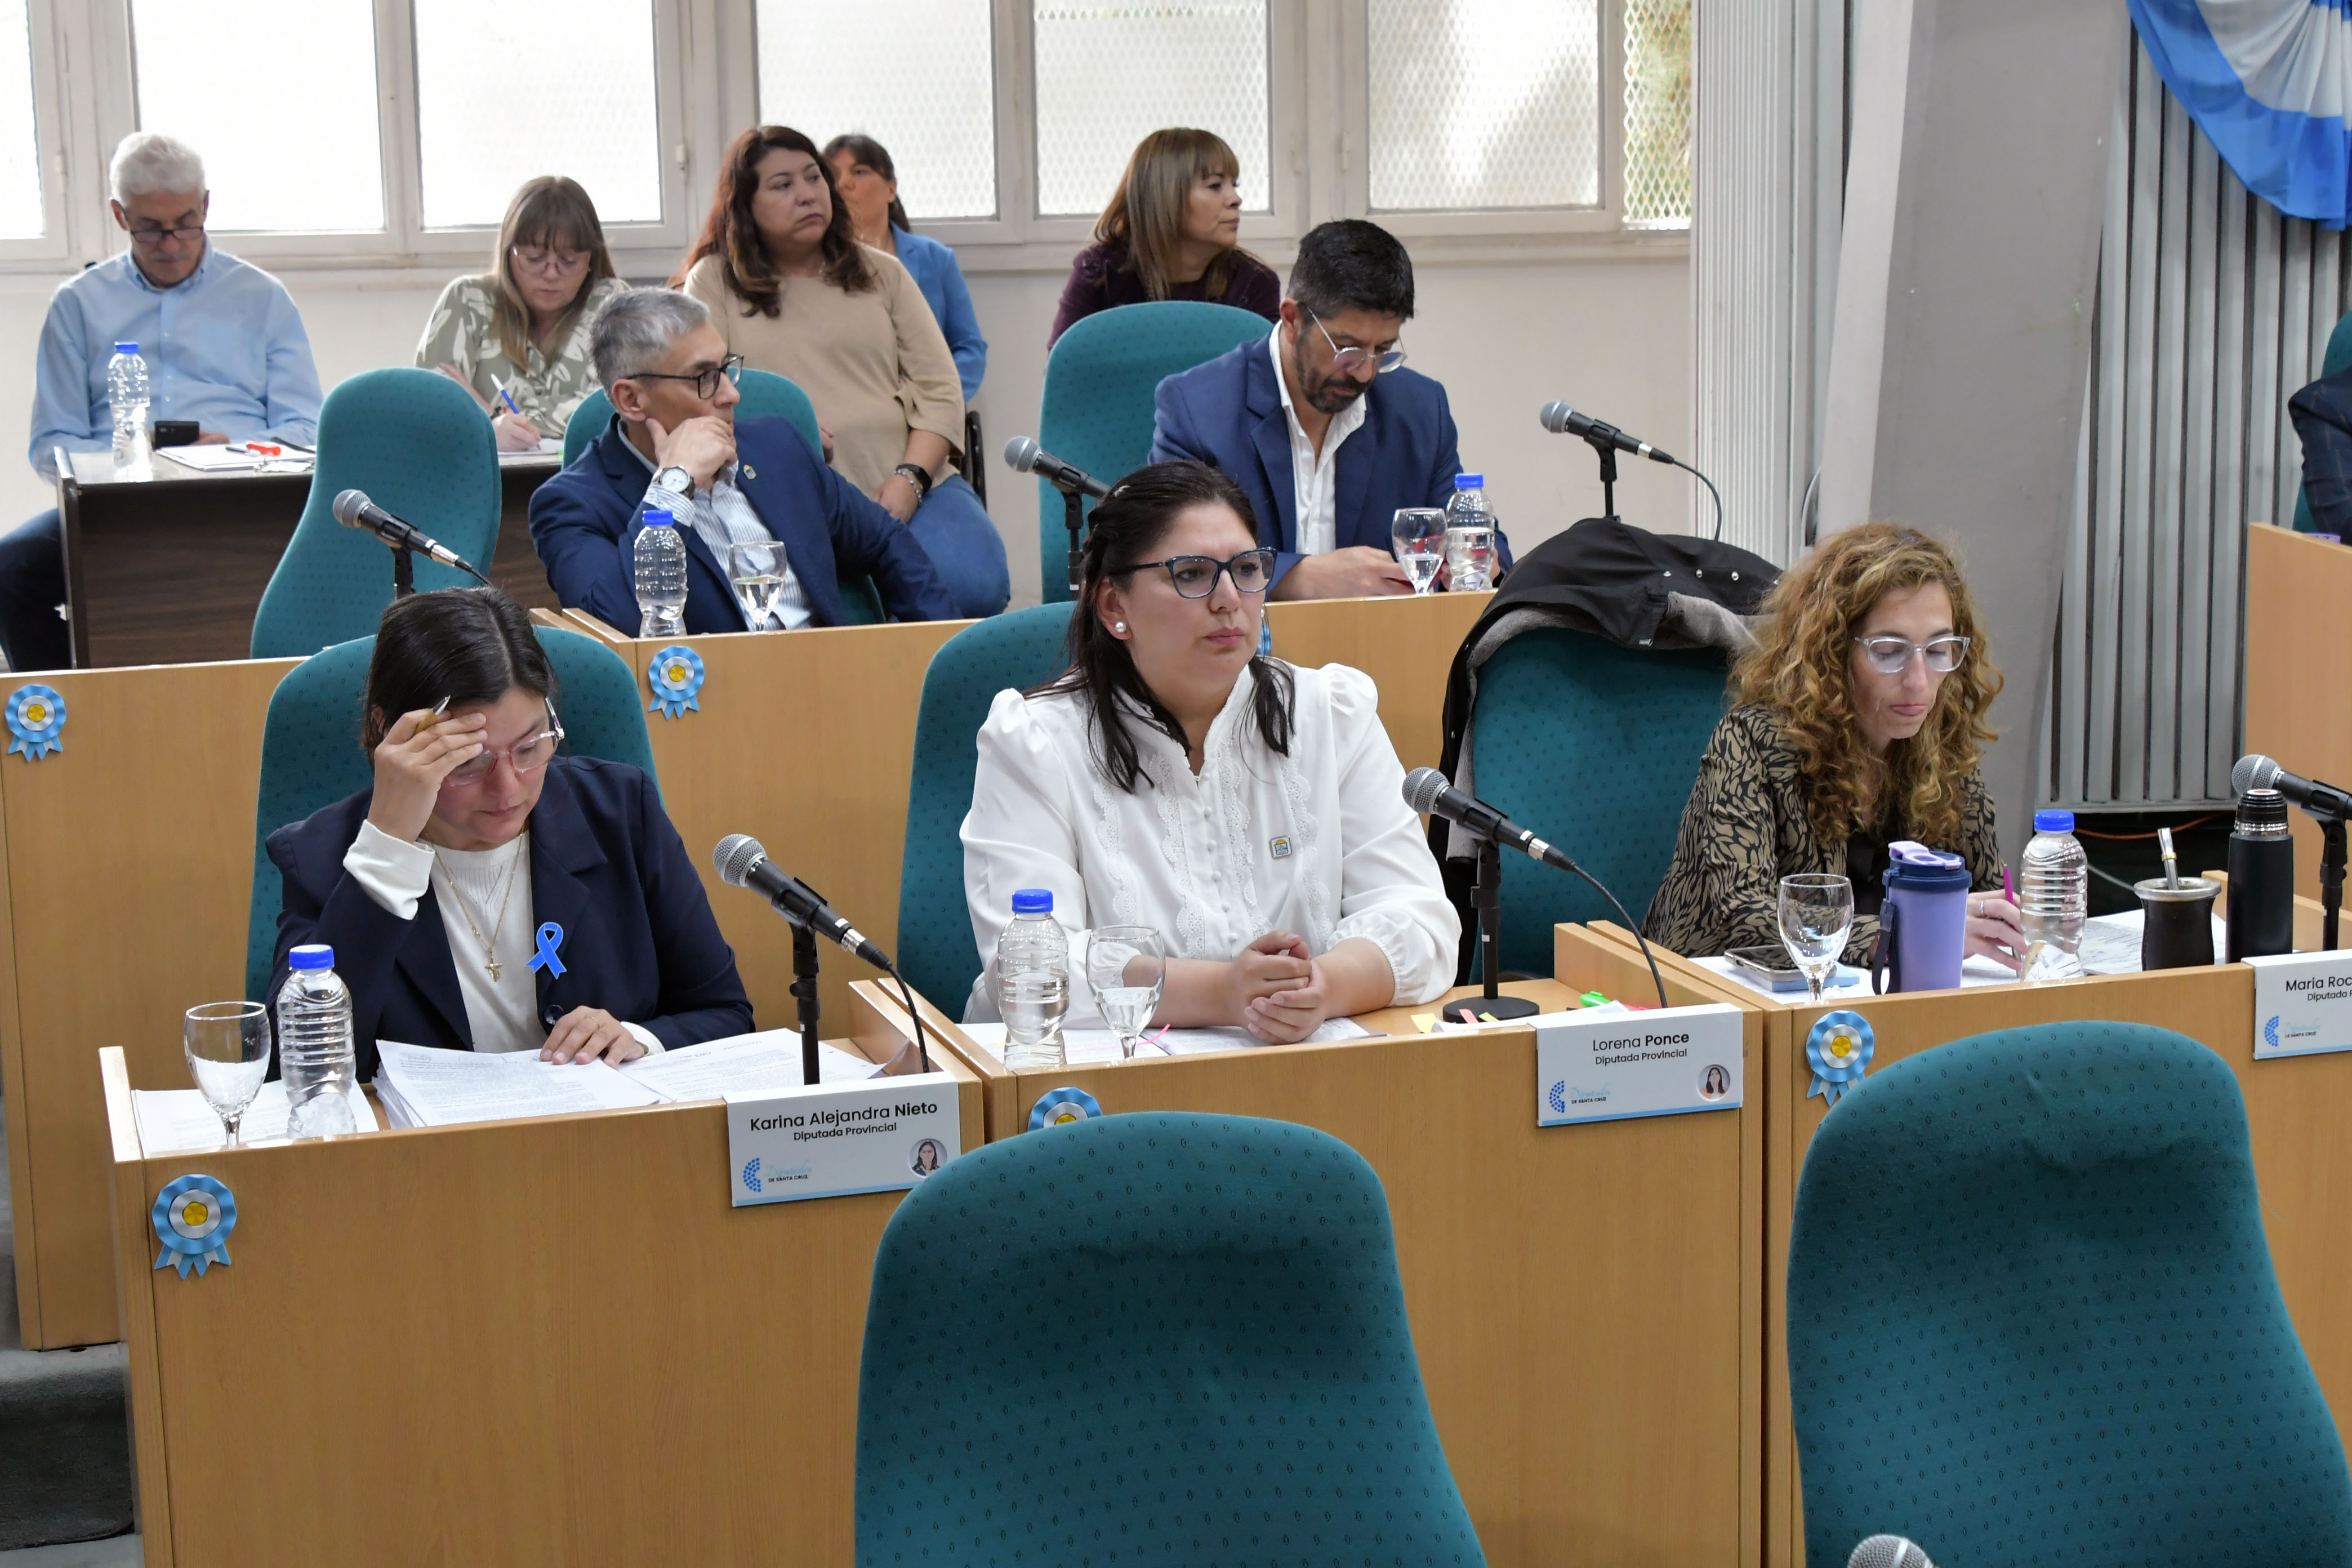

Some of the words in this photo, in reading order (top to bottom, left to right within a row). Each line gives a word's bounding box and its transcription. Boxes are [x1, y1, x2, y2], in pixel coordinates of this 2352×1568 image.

[2286, 977, 2324, 991] Maria
[2307, 990, 2347, 1003] Diputada
[1593, 1037, 1641, 1052] Lorena
[1645, 1033, 1690, 1047] Ponce
[1595, 1052, 1640, 1066] Diputada
[1641, 1048, 1687, 1061] Provincial
[750, 1114, 804, 1131] Karina
[809, 1106, 890, 1126] Alejandra
[894, 1102, 938, 1117] Nieto
[794, 1127, 843, 1142] Diputada
[845, 1122, 897, 1136] Provincial
